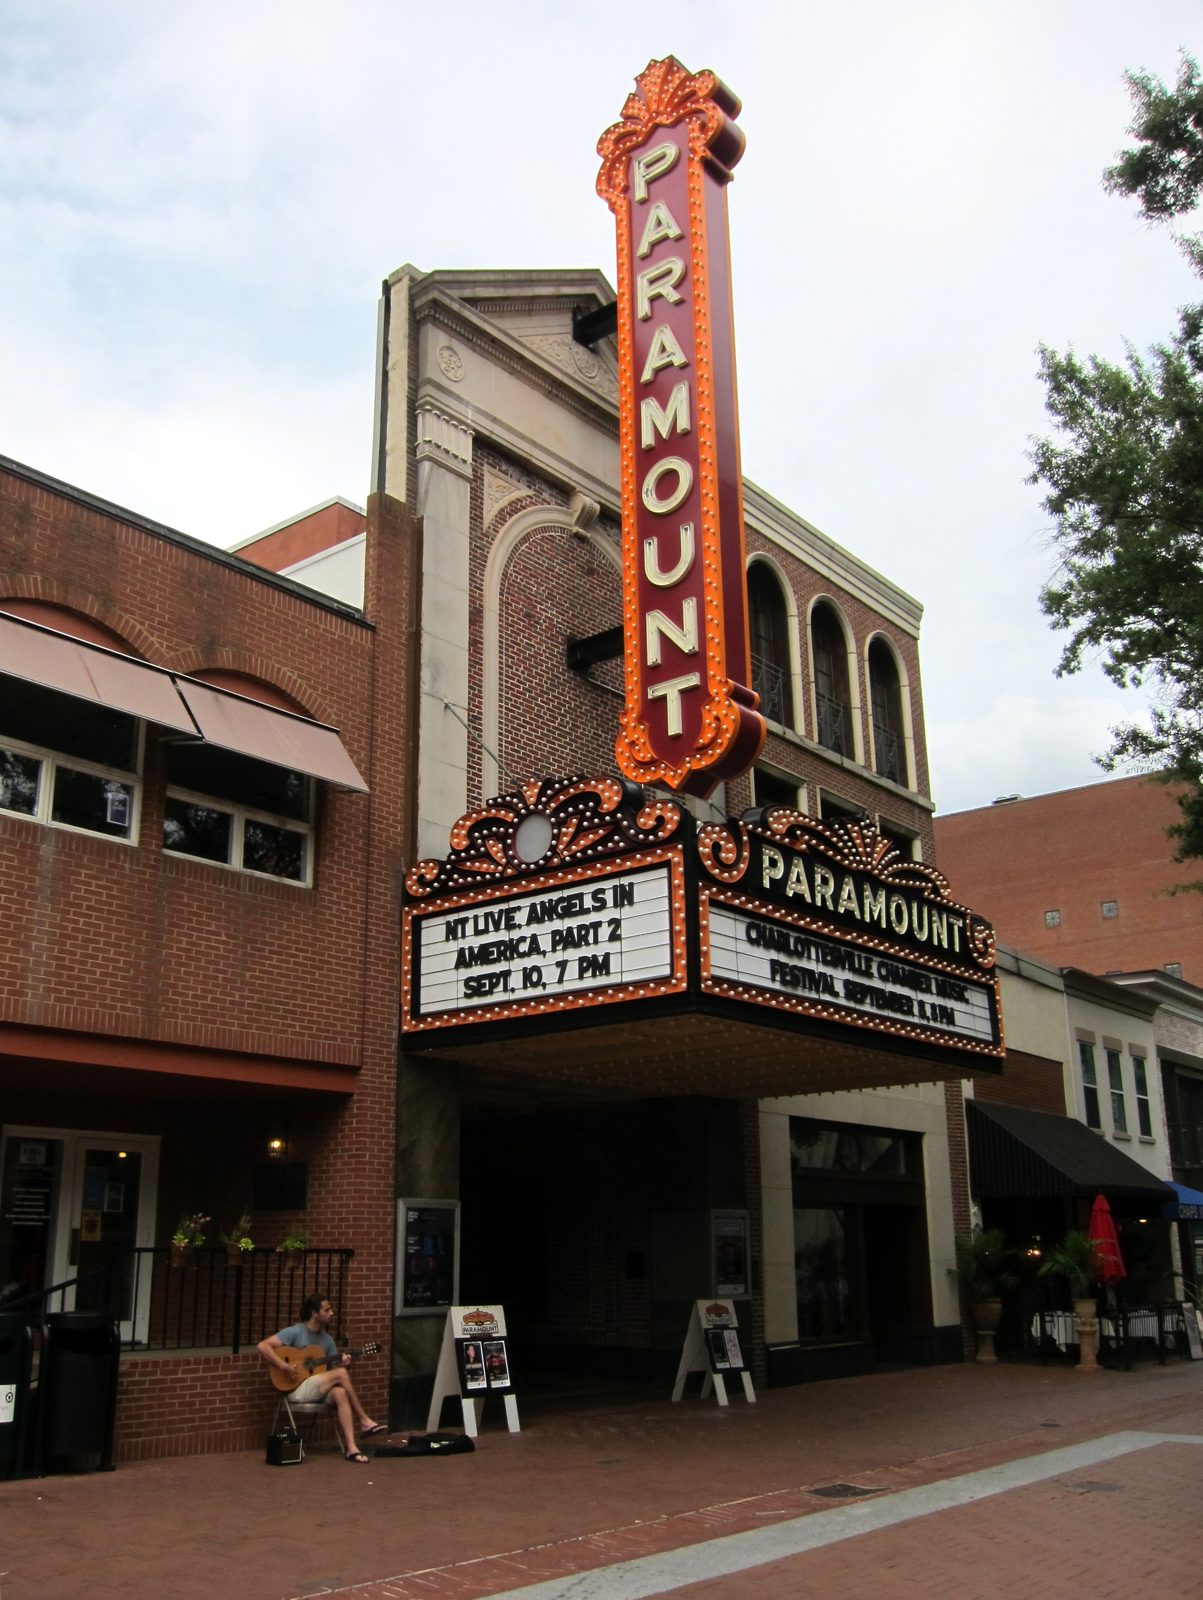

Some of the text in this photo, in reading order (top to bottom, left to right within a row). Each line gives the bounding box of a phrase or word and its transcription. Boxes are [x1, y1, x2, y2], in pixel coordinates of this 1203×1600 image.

[632, 140, 700, 738] PARAMOUNT
[445, 917, 470, 942] NT
[525, 887, 607, 926] ANGELS
[612, 882, 635, 909] IN
[762, 843, 963, 953] PARAMOUNT
[454, 917, 622, 971] AMERICA, PART 2
[746, 921, 874, 979] CHARLOTTESVILLE
[463, 952, 611, 998] SEPT. 10, 7 PM
[843, 979, 915, 1018] SEPTEMBER
